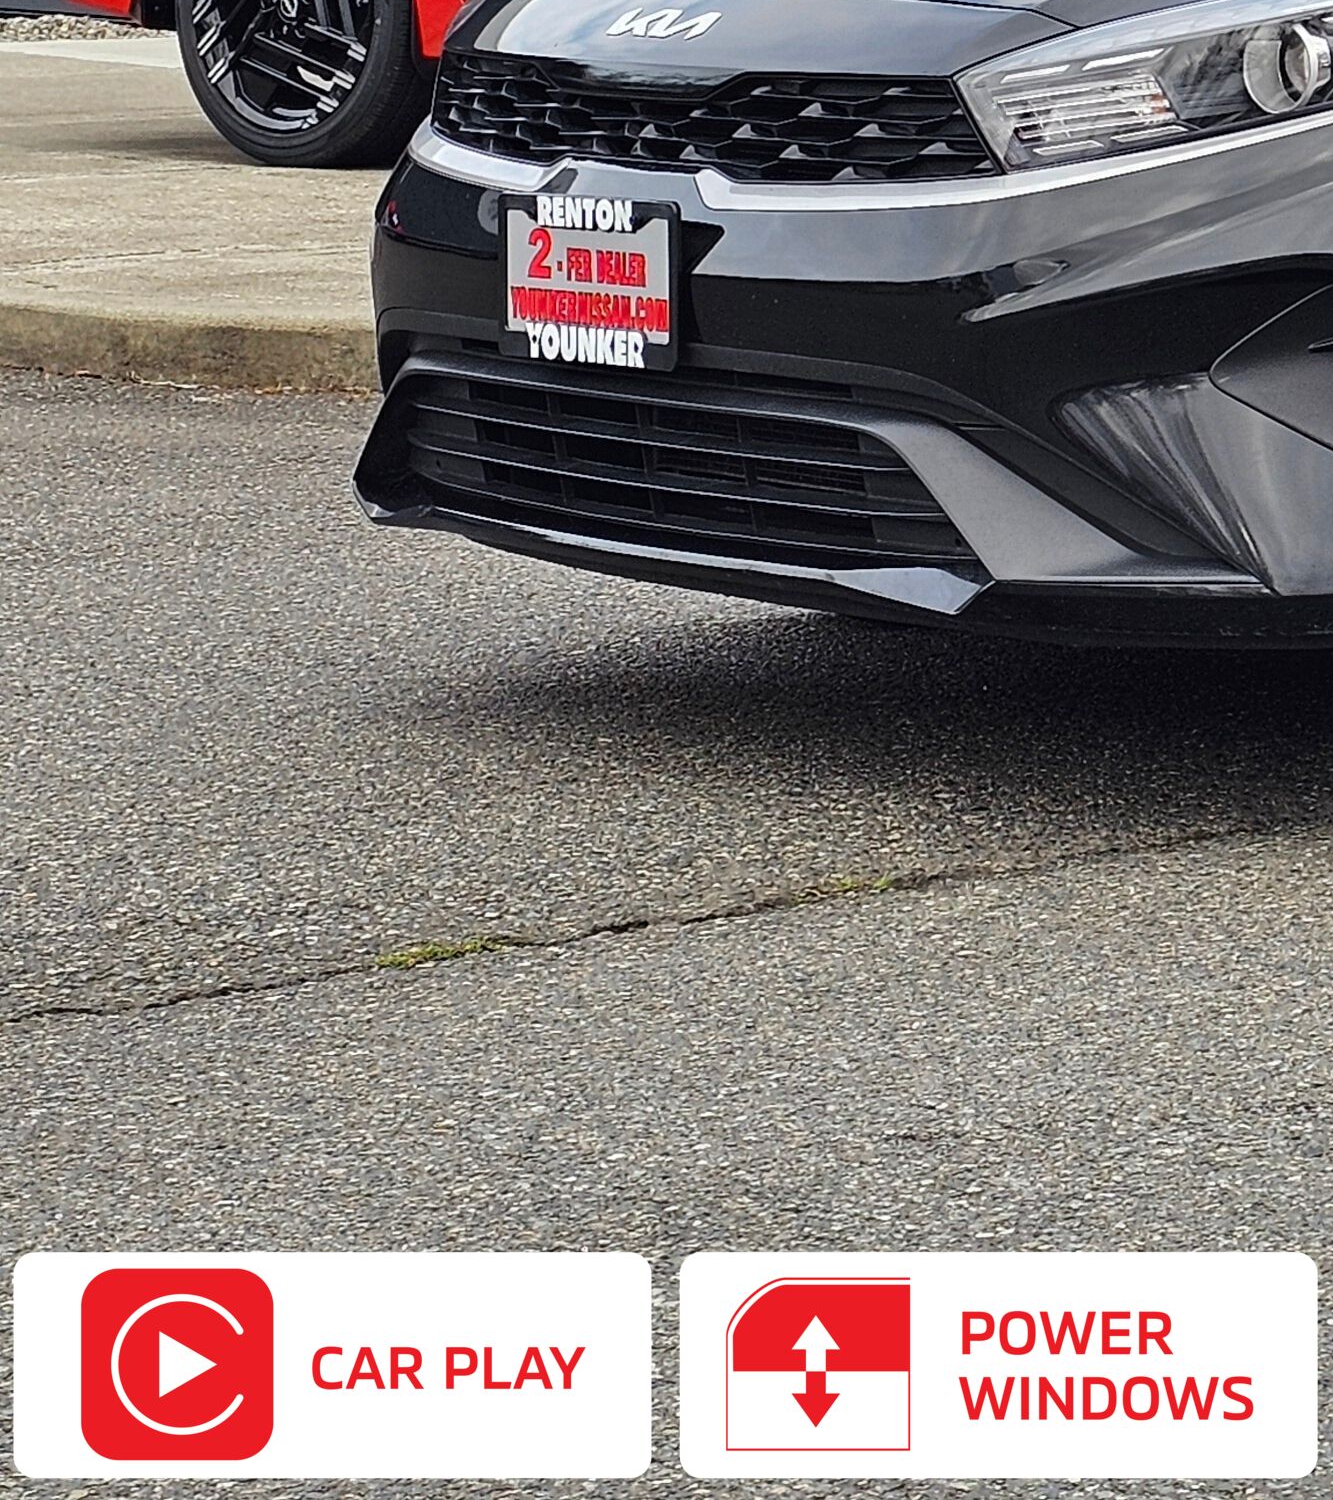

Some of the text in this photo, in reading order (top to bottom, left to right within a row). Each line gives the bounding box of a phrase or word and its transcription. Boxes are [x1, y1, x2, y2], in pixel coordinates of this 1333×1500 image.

[606, 7, 723, 40] KIA
[536, 195, 633, 232] RENTON
[597, 249, 646, 288] DEALER
[511, 285, 668, 333] YOUNKERNISSAN.COM
[526, 322, 645, 369] YOUNKER
